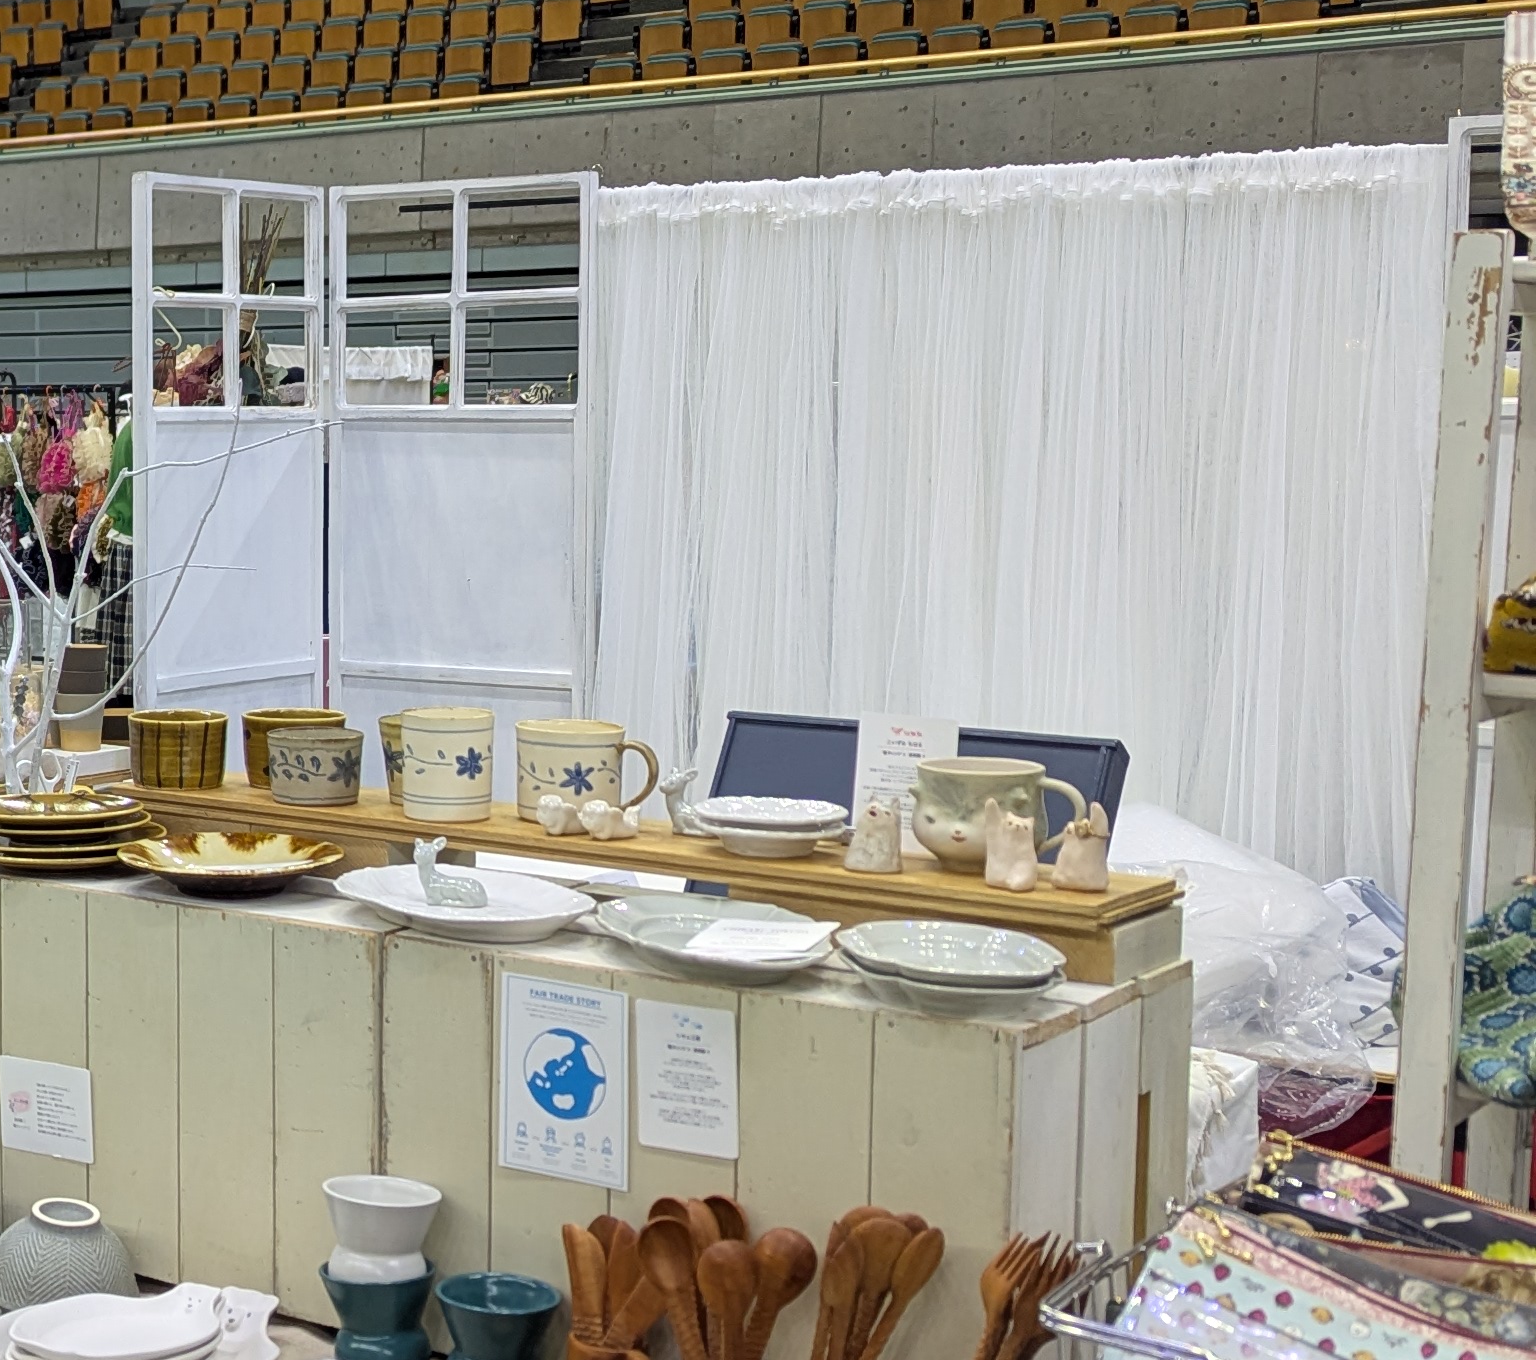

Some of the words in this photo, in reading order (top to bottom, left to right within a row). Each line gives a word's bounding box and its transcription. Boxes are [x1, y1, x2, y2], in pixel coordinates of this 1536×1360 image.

[529, 988, 547, 998] FAIR
[549, 991, 574, 1003] TRADE
[576, 997, 602, 1008] STORY
